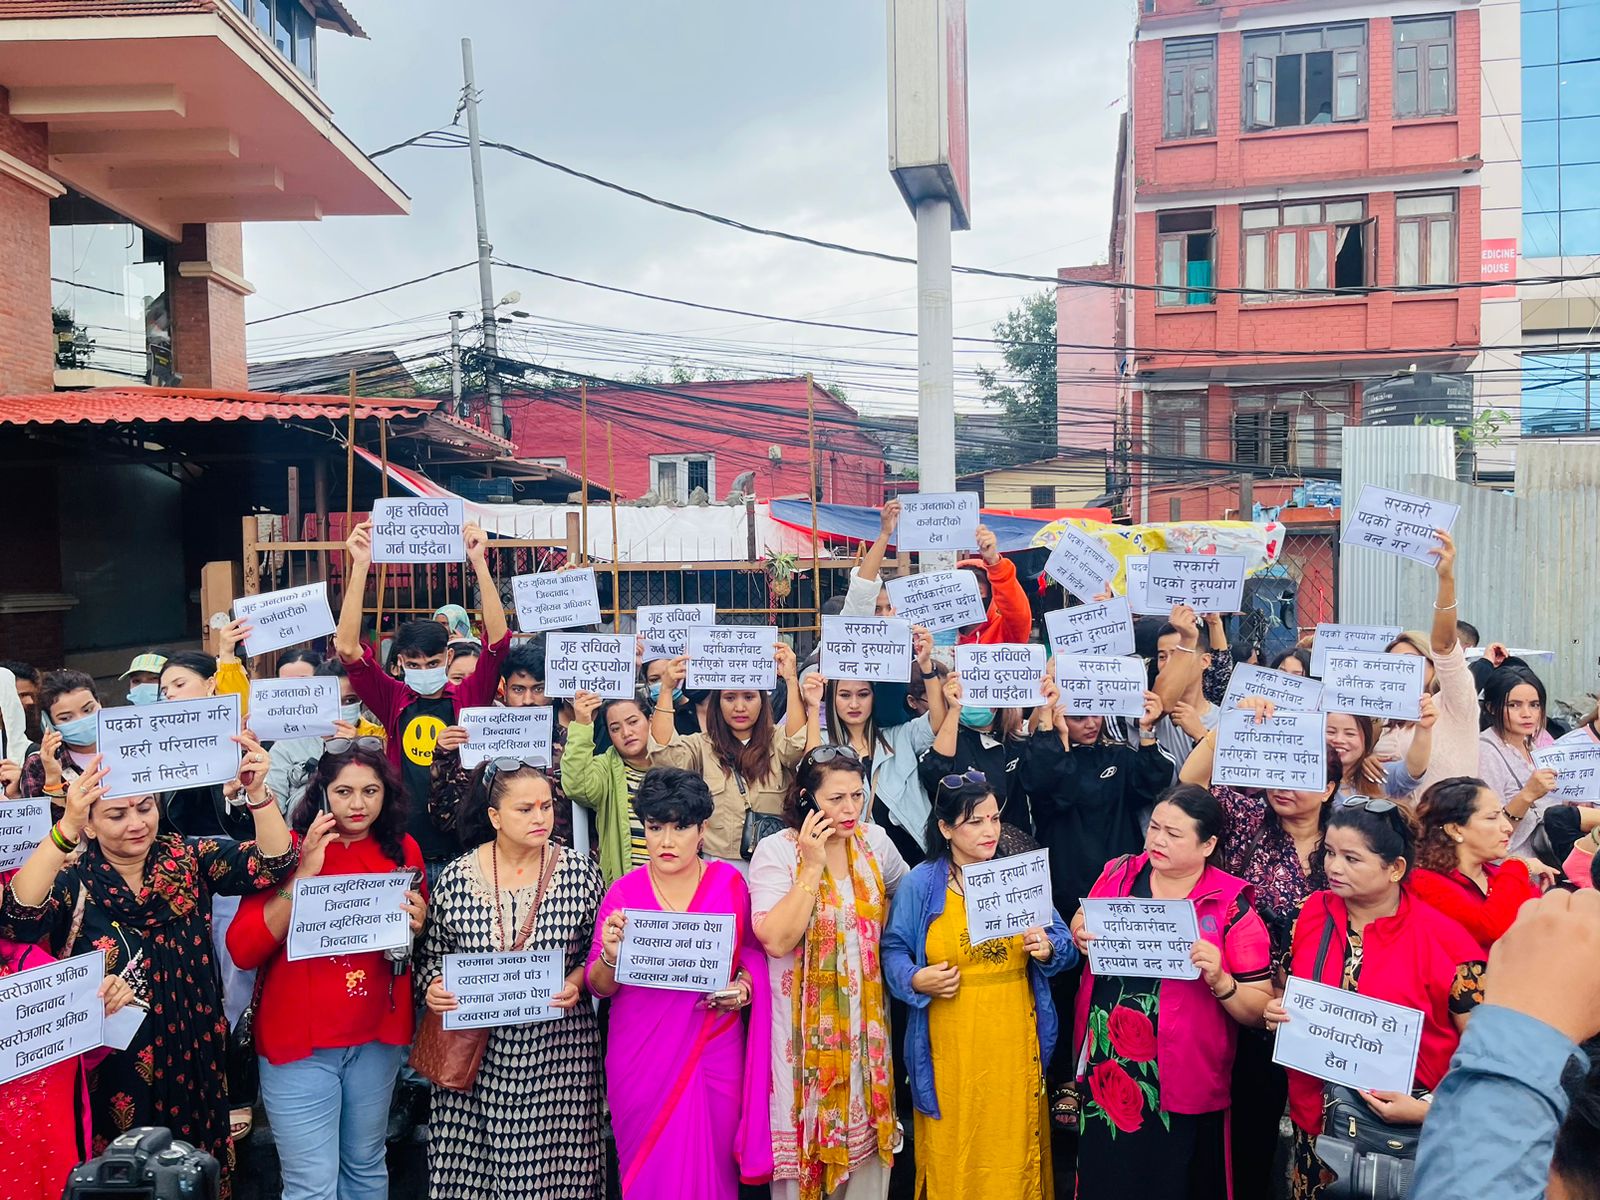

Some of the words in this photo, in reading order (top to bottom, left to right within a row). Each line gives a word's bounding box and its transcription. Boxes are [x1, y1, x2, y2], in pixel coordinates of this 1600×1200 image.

[1482, 249, 1515, 259] EDICINE
[1481, 264, 1509, 273] HOUSE
[386, 505, 403, 519] गृह
[408, 502, 448, 517] सचिवले
[1384, 497, 1432, 519] सरकारी
[1358, 511, 1391, 528] पदको
[377, 521, 405, 536] पदीय
[386, 541, 404, 554] गर्न
[1391, 539, 1411, 552] गर
[1173, 558, 1220, 574] सरकारी
[1153, 576, 1184, 589] पदको
[1193, 597, 1209, 607] गर
[648, 612, 662, 625] गृह
[666, 608, 700, 622] सचिवले
[1068, 605, 1108, 625] सरकारी
[845, 620, 888, 636] सरकारी
[737, 631, 756, 640] उच्च
[1055, 630, 1082, 646] पदको
[561, 641, 577, 655] गृह
[581, 638, 621, 653] सचिवले
[827, 639, 856, 653] पदको
[970, 651, 987, 665] गृह
[992, 647, 1031, 662] सचिवले
[551, 657, 578, 671] पदीय
[729, 660, 748, 671] चरम
[753, 658, 773, 670] पदीय
[865, 662, 881, 675] गर
[1079, 659, 1121, 674] सरकारी
[1330, 657, 1358, 671] गृहको
[750, 675, 762, 684] गर
[961, 666, 990, 681] पदीय
[559, 677, 576, 690] गर्न
[1061, 677, 1091, 693] पदको
[1336, 674, 1375, 689] अनैतिक
[970, 686, 988, 699] गर्न
[1099, 699, 1116, 711] गर
[1337, 693, 1355, 707] दिन
[105, 714, 143, 732] पदको
[150, 710, 201, 732] दुरुपयोग
[208, 704, 231, 720] गरि
[1273, 716, 1297, 726] उच्च
[120, 739, 152, 759] प्रहरी
[159, 735, 218, 752] परिचालन
[1263, 751, 1287, 763] चरम
[1293, 750, 1319, 765] पदीय
[1291, 770, 1306, 784] गर
[968, 869, 995, 887] पदको
[1031, 856, 1045, 872] गरि
[300, 884, 330, 896] नेपाल
[325, 898, 371, 912] जिन्दावाद
[977, 892, 1000, 911] प्रहरी
[1006, 885, 1043, 903] परिचालन
[1140, 904, 1165, 914] उच्च
[296, 922, 325, 933] नेपाल
[634, 919, 669, 930] सम्मान
[672, 921, 700, 931] जनक
[704, 920, 723, 933] पेशा
[321, 934, 368, 948] जिन्दावाद
[633, 936, 672, 948] व्यवसाय
[675, 938, 692, 949] गर्न
[1137, 940, 1162, 952] चरम
[457, 958, 494, 968] सम्मान
[498, 956, 526, 965] जनक
[531, 954, 550, 963] पेशा
[630, 955, 665, 966] सम्मान
[668, 958, 696, 968] जनक
[700, 957, 719, 970] पेशा
[1168, 960, 1184, 973] गर
[56, 965, 88, 985] श्रमिक
[458, 973, 499, 985] व्यवसाय
[503, 970, 520, 982] गर्न
[629, 972, 668, 982] व्यवसाय
[671, 974, 688, 983] गर्न
[457, 994, 494, 1005] सम्मान
[498, 991, 526, 1002] जनक
[531, 987, 550, 998] पेशा
[16, 995, 66, 1020] जिन्दावाद
[1294, 993, 1315, 1009] गृह
[1319, 1000, 1378, 1027] जनताको
[1382, 1016, 1398, 1033] हो
[56, 1010, 88, 1031] श्रमिक
[458, 1010, 499, 1022] व्यवसाय
[503, 1008, 520, 1017] गर्न
[1309, 1022, 1383, 1054] कर्मचारीको
[16, 1040, 65, 1068] जिन्दावाद
[1325, 1050, 1347, 1071] हैन
